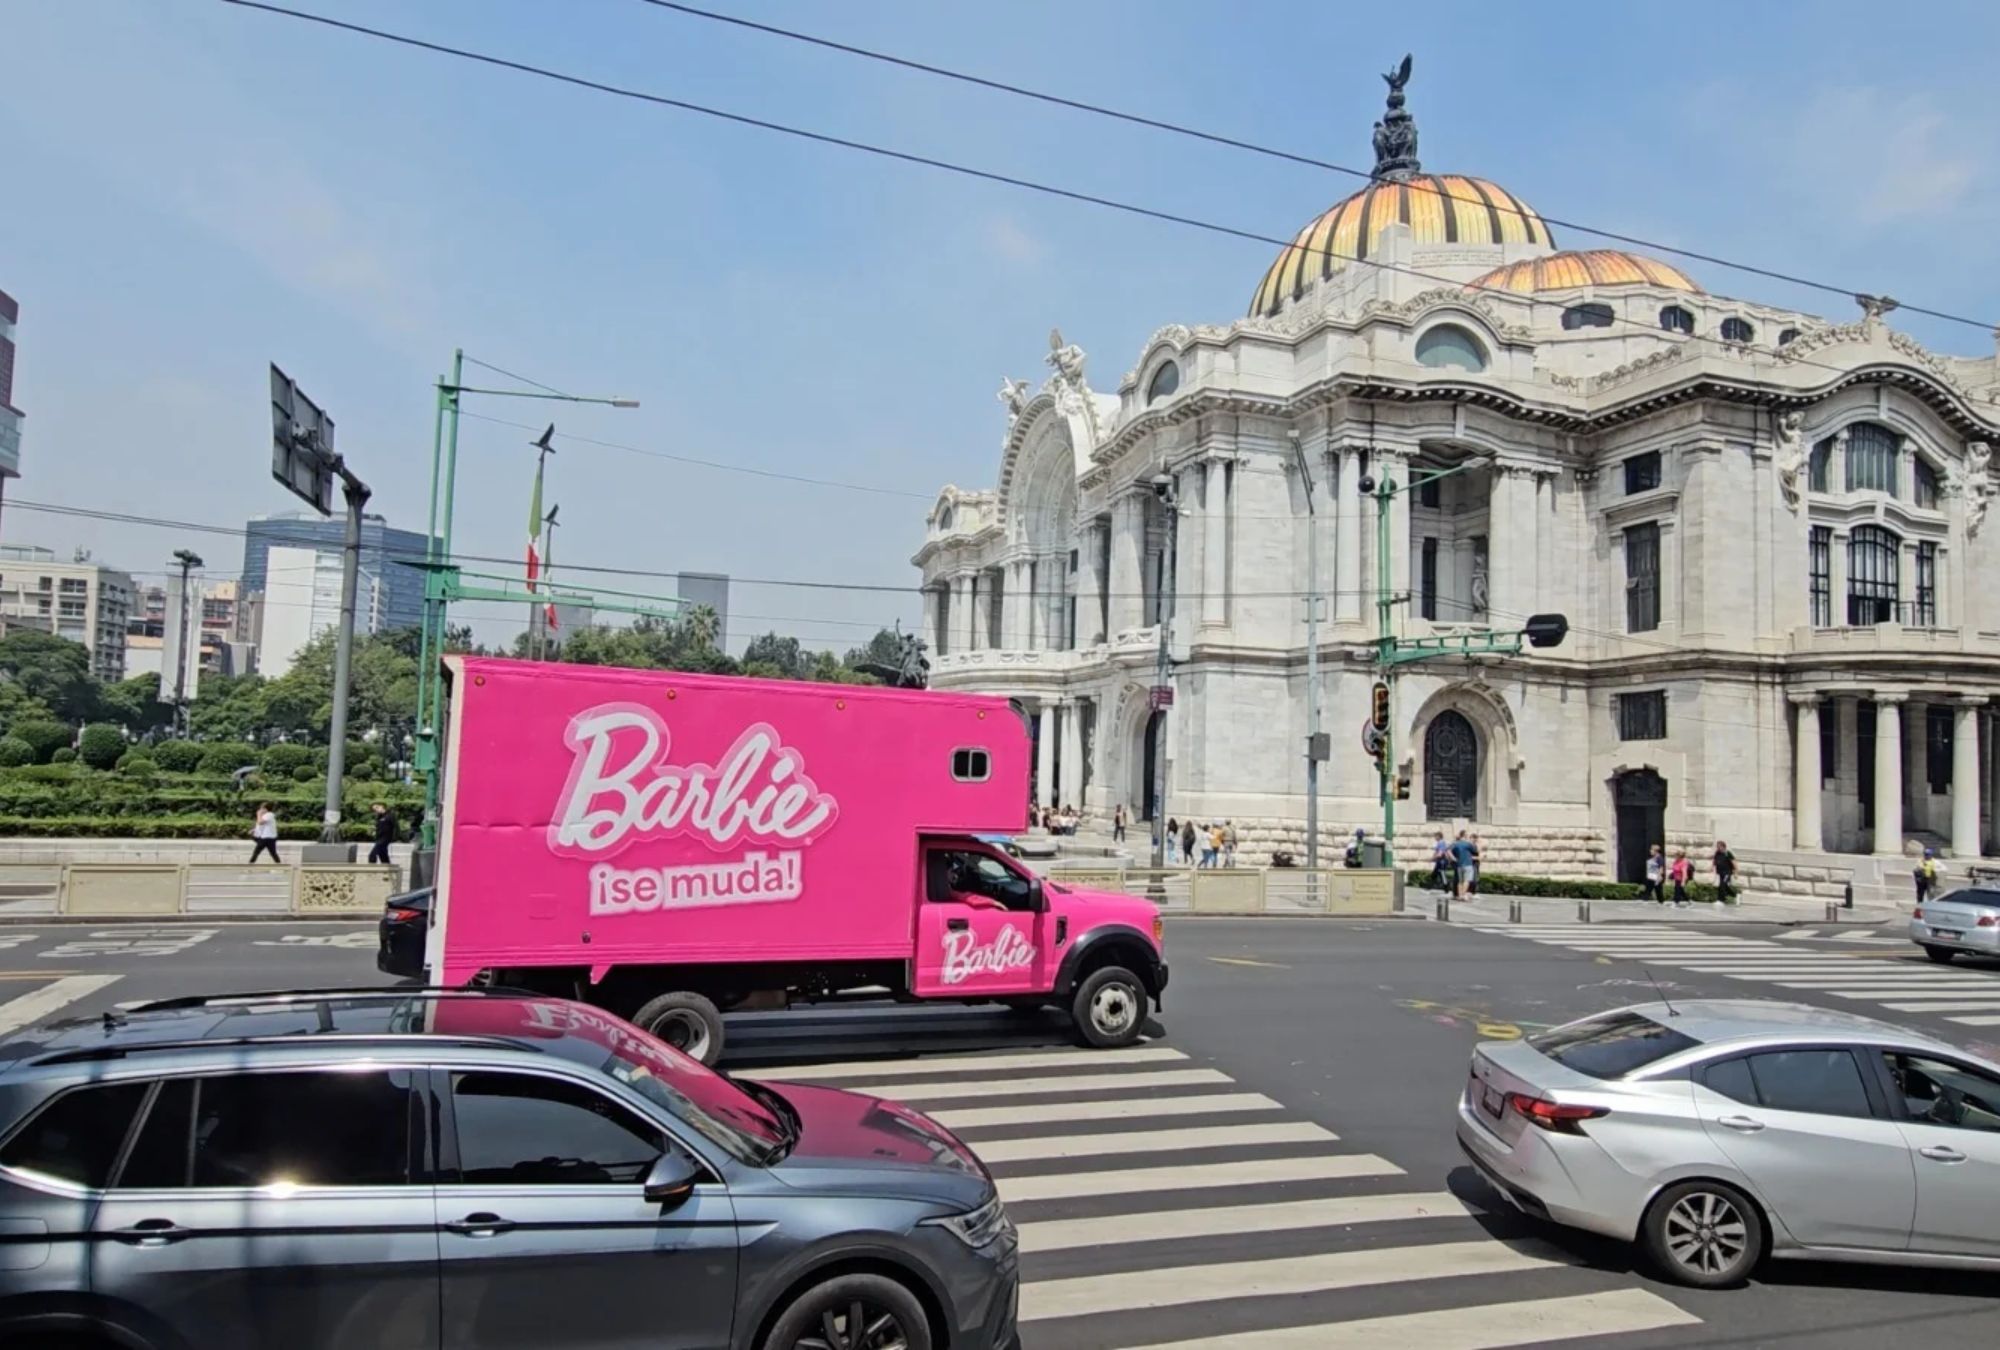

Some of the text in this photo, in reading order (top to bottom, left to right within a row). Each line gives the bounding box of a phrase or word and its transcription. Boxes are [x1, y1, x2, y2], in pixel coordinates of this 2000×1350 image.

[557, 711, 830, 850] Barbie
[671, 858, 795, 898] muda!
[943, 925, 1035, 983] Barbie
